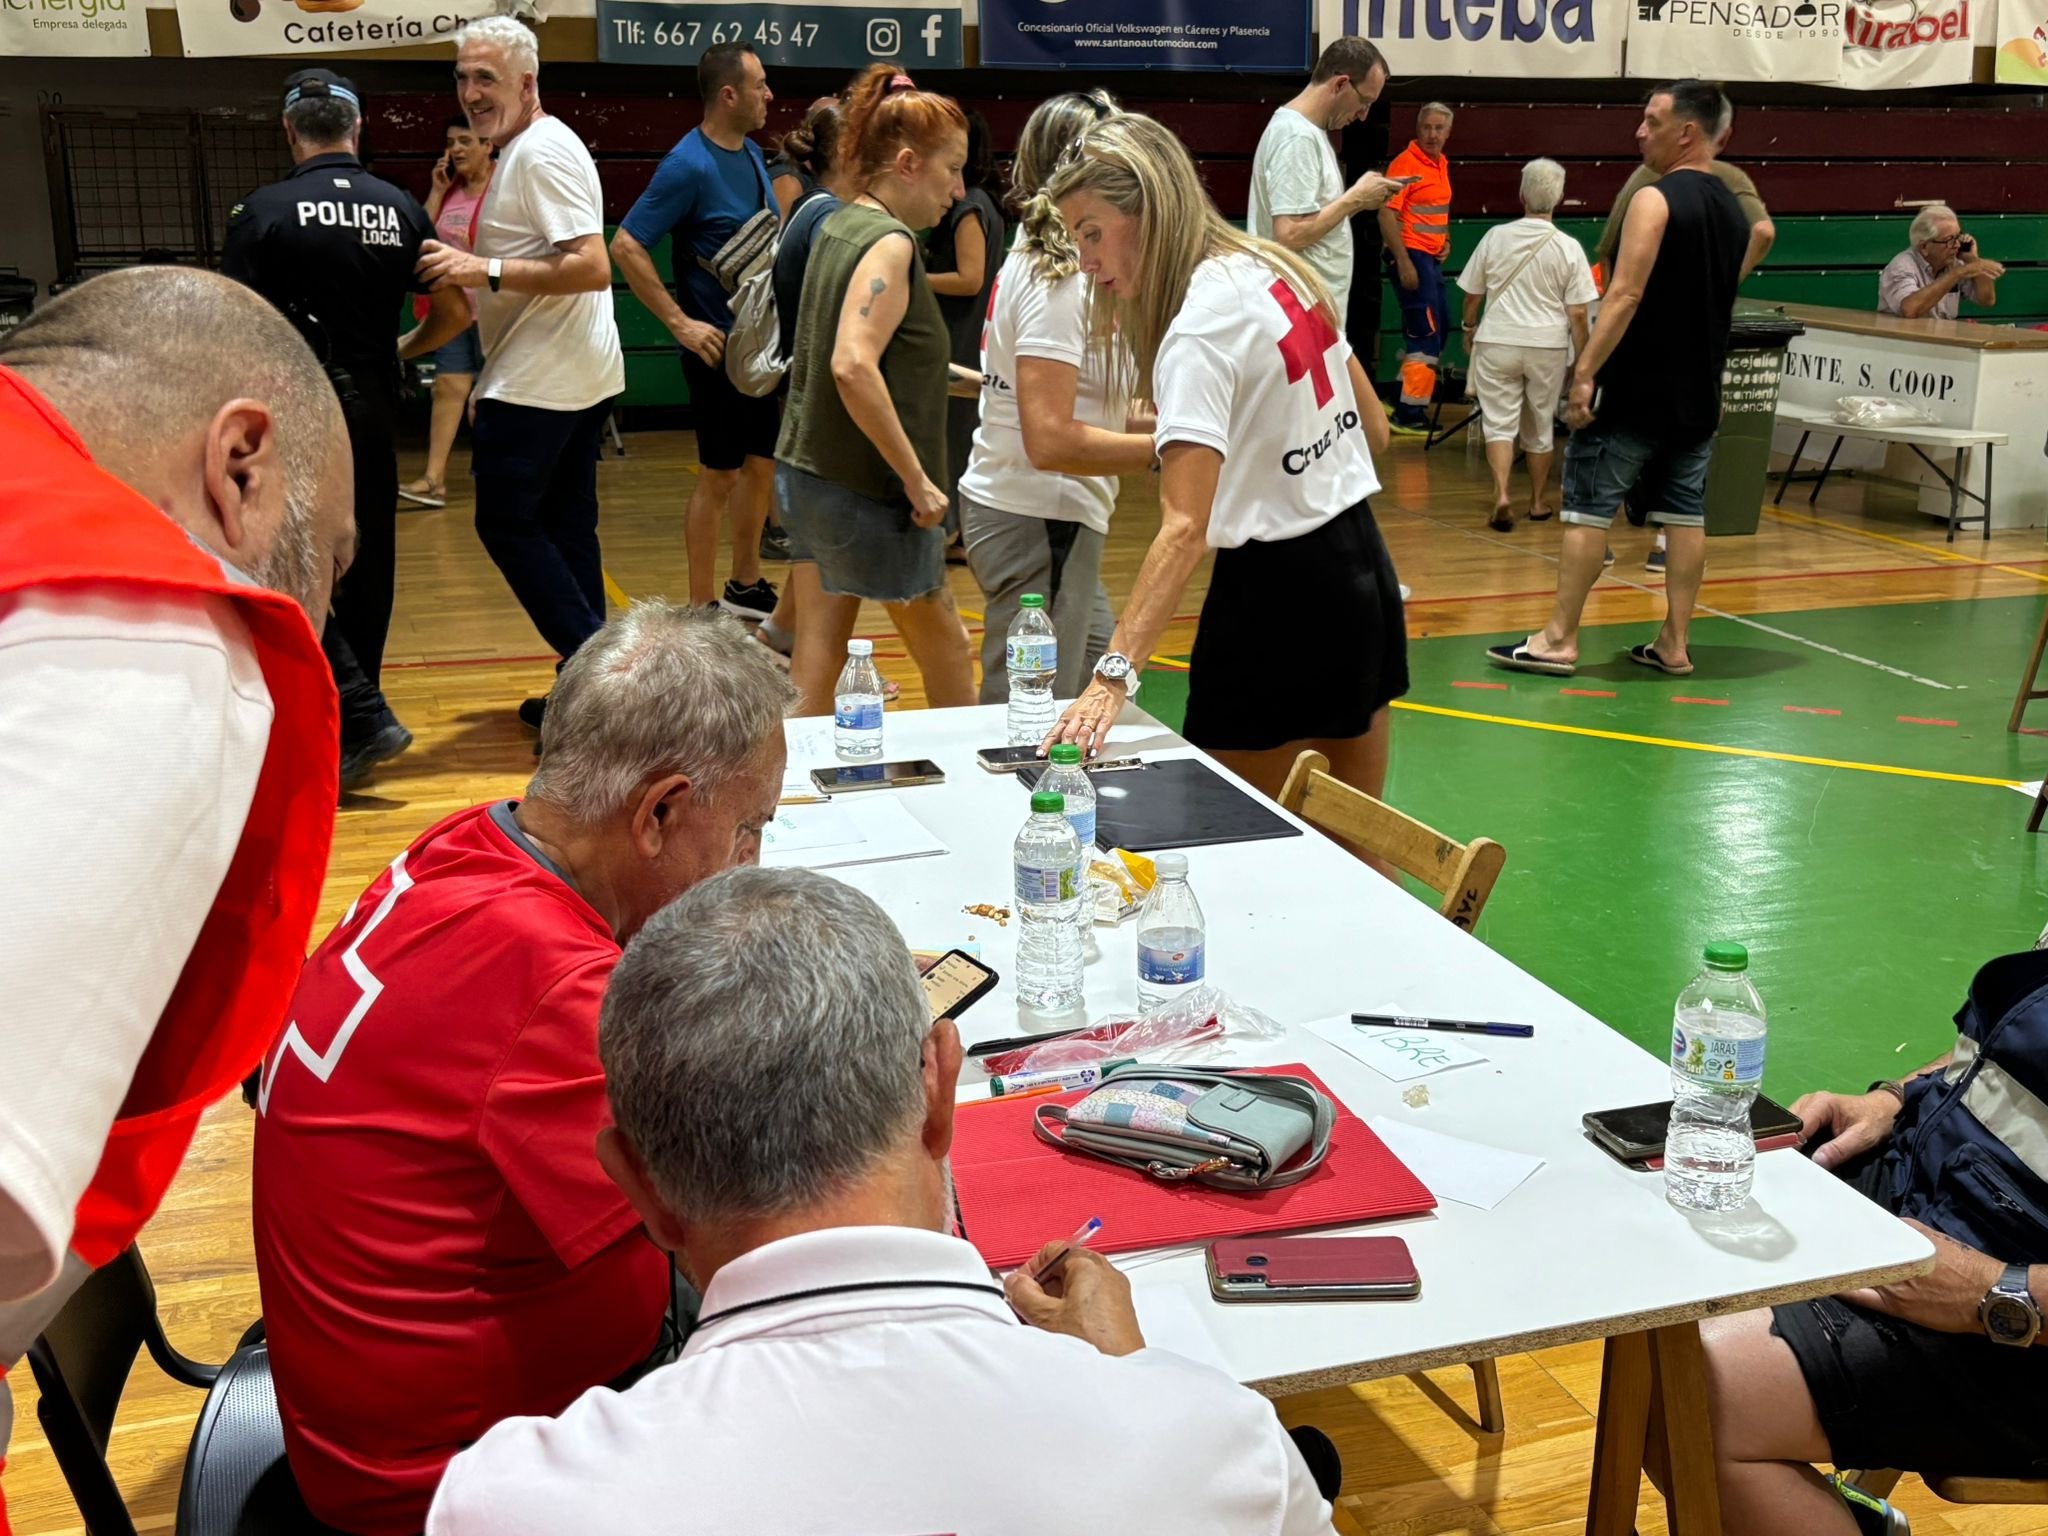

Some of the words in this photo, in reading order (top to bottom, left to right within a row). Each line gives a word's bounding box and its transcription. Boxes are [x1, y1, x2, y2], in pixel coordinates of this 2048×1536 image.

[32, 18, 79, 31] Empresa
[81, 19, 128, 31] delegada
[284, 16, 423, 43] Cafetería
[432, 14, 477, 33] Ch
[654, 21, 701, 46] 667
[711, 22, 743, 46] 62
[754, 19, 782, 46] 45
[790, 21, 819, 47] 47
[1017, 22, 1084, 33] Concesionario
[1085, 23, 1114, 33] Oficial
[1115, 24, 1172, 36] Volkswagen
[1173, 26, 1183, 34] en
[1185, 24, 1220, 35] Cáceres
[1221, 27, 1228, 37] y
[1229, 26, 1270, 36] Plasencia
[1733, 29, 1784, 39] DESDE
[1799, 29, 1839, 38] 1990
[1074, 38, 1218, 49] www.santanoautomocion.com
[297, 201, 401, 231] POLICIA
[362, 229, 403, 247] LOCAL
[1858, 363, 1875, 389] S.
[1889, 368, 1957, 403] COOP.
[1282, 429, 1332, 476] Cruz
